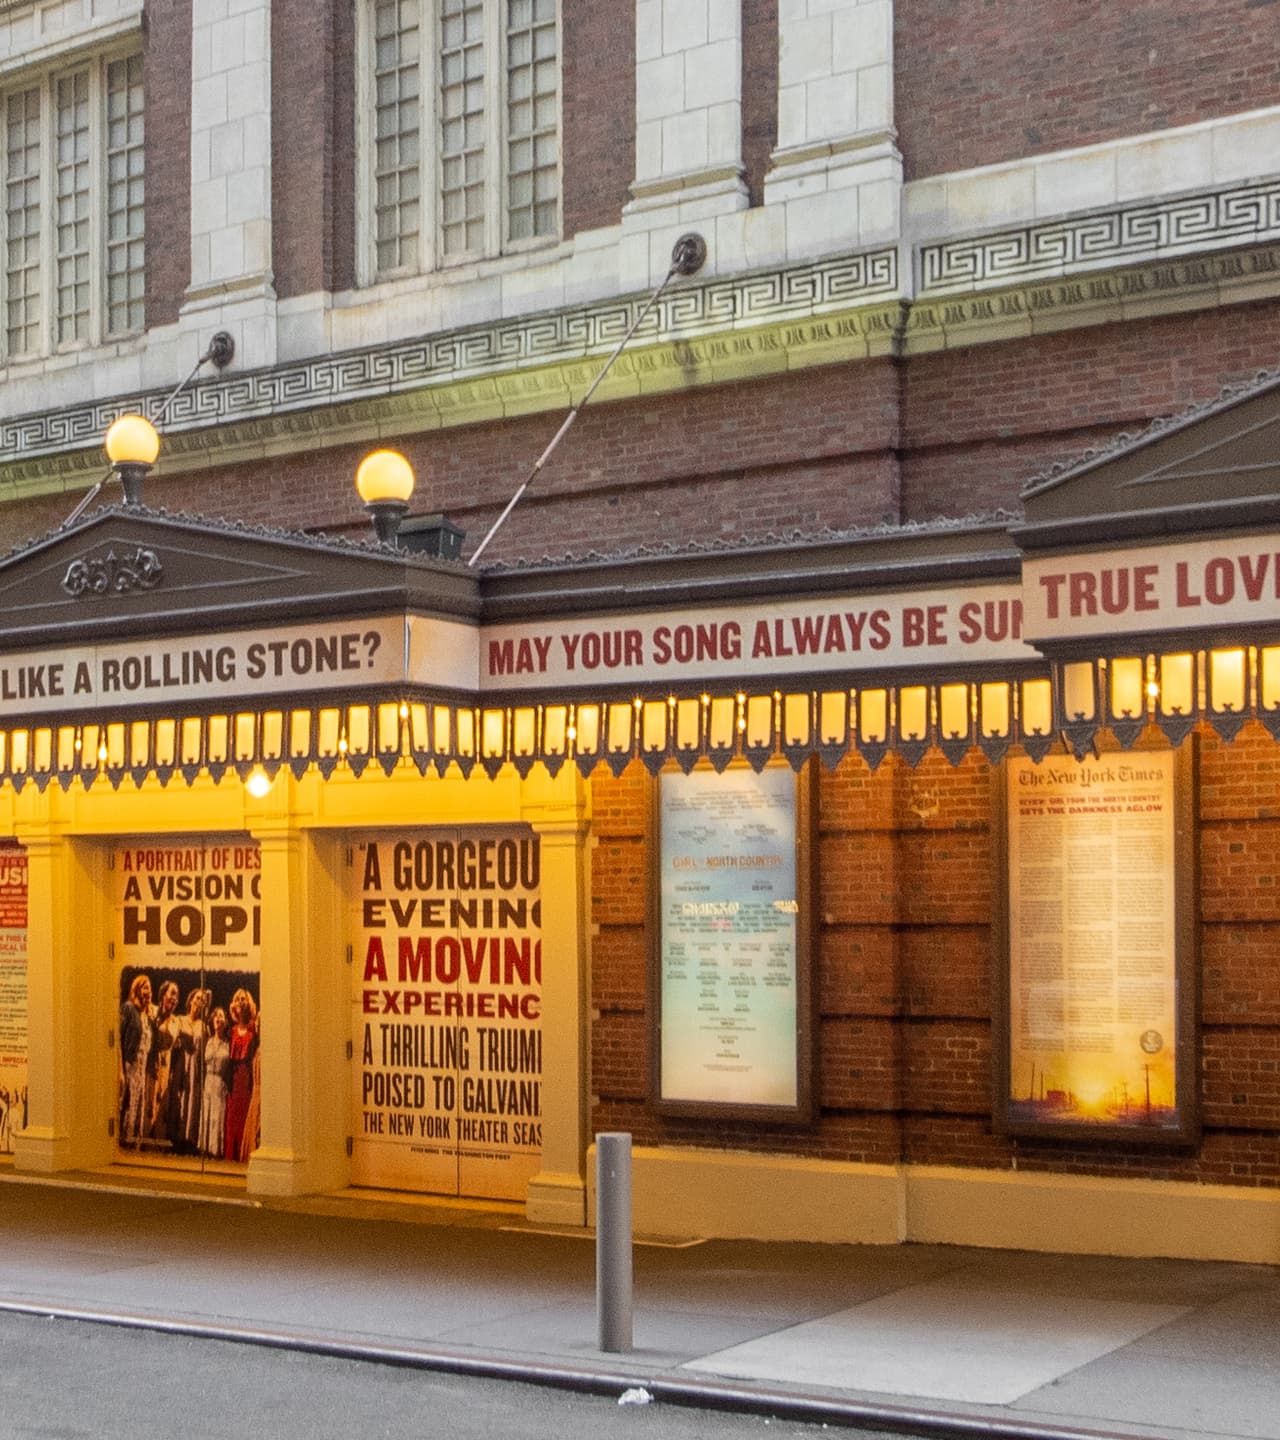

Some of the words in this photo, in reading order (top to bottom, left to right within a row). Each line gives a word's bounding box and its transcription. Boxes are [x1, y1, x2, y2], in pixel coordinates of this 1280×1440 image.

[1039, 565, 1161, 620] TRUE
[489, 635, 549, 677] MAY
[561, 628, 643, 672] YOUR
[653, 620, 742, 666] SONG
[751, 610, 891, 659] ALWAYS
[901, 605, 948, 648] BE
[1, 663, 64, 701] LIKE
[73, 661, 93, 694] A
[102, 645, 236, 693] ROLLING
[245, 630, 383, 680] STONE?
[1019, 770, 1045, 787] The
[1047, 768, 1077, 785] New
[1080, 767, 1115, 788] York
[1118, 766, 1164, 782] Times
[1047, 806, 1064, 815] THE
[1069, 805, 1122, 814] DARKNESS
[1126, 804, 1163, 812] AGLOW
[136, 849, 206, 871] PORTRAIT
[211, 848, 230, 871] OF
[393, 839, 541, 891] GORGEOU
[123, 875, 142, 901] A
[148, 874, 243, 901] VISION
[363, 936, 388, 982] A
[398, 936, 542, 985] MOVIN
[362, 989, 541, 1020] EXPERIENC
[363, 1022, 373, 1066] A
[380, 1023, 470, 1071] THRILLING
[477, 1027, 542, 1075] TRIUM
[362, 1071, 425, 1109] POISED
[433, 1075, 455, 1111] TO
[463, 1077, 542, 1118] GALVANI
[363, 1111, 385, 1134] THE
[389, 1114, 415, 1137] NEW
[420, 1116, 451, 1139] YORK
[456, 1118, 508, 1144] THEATER
